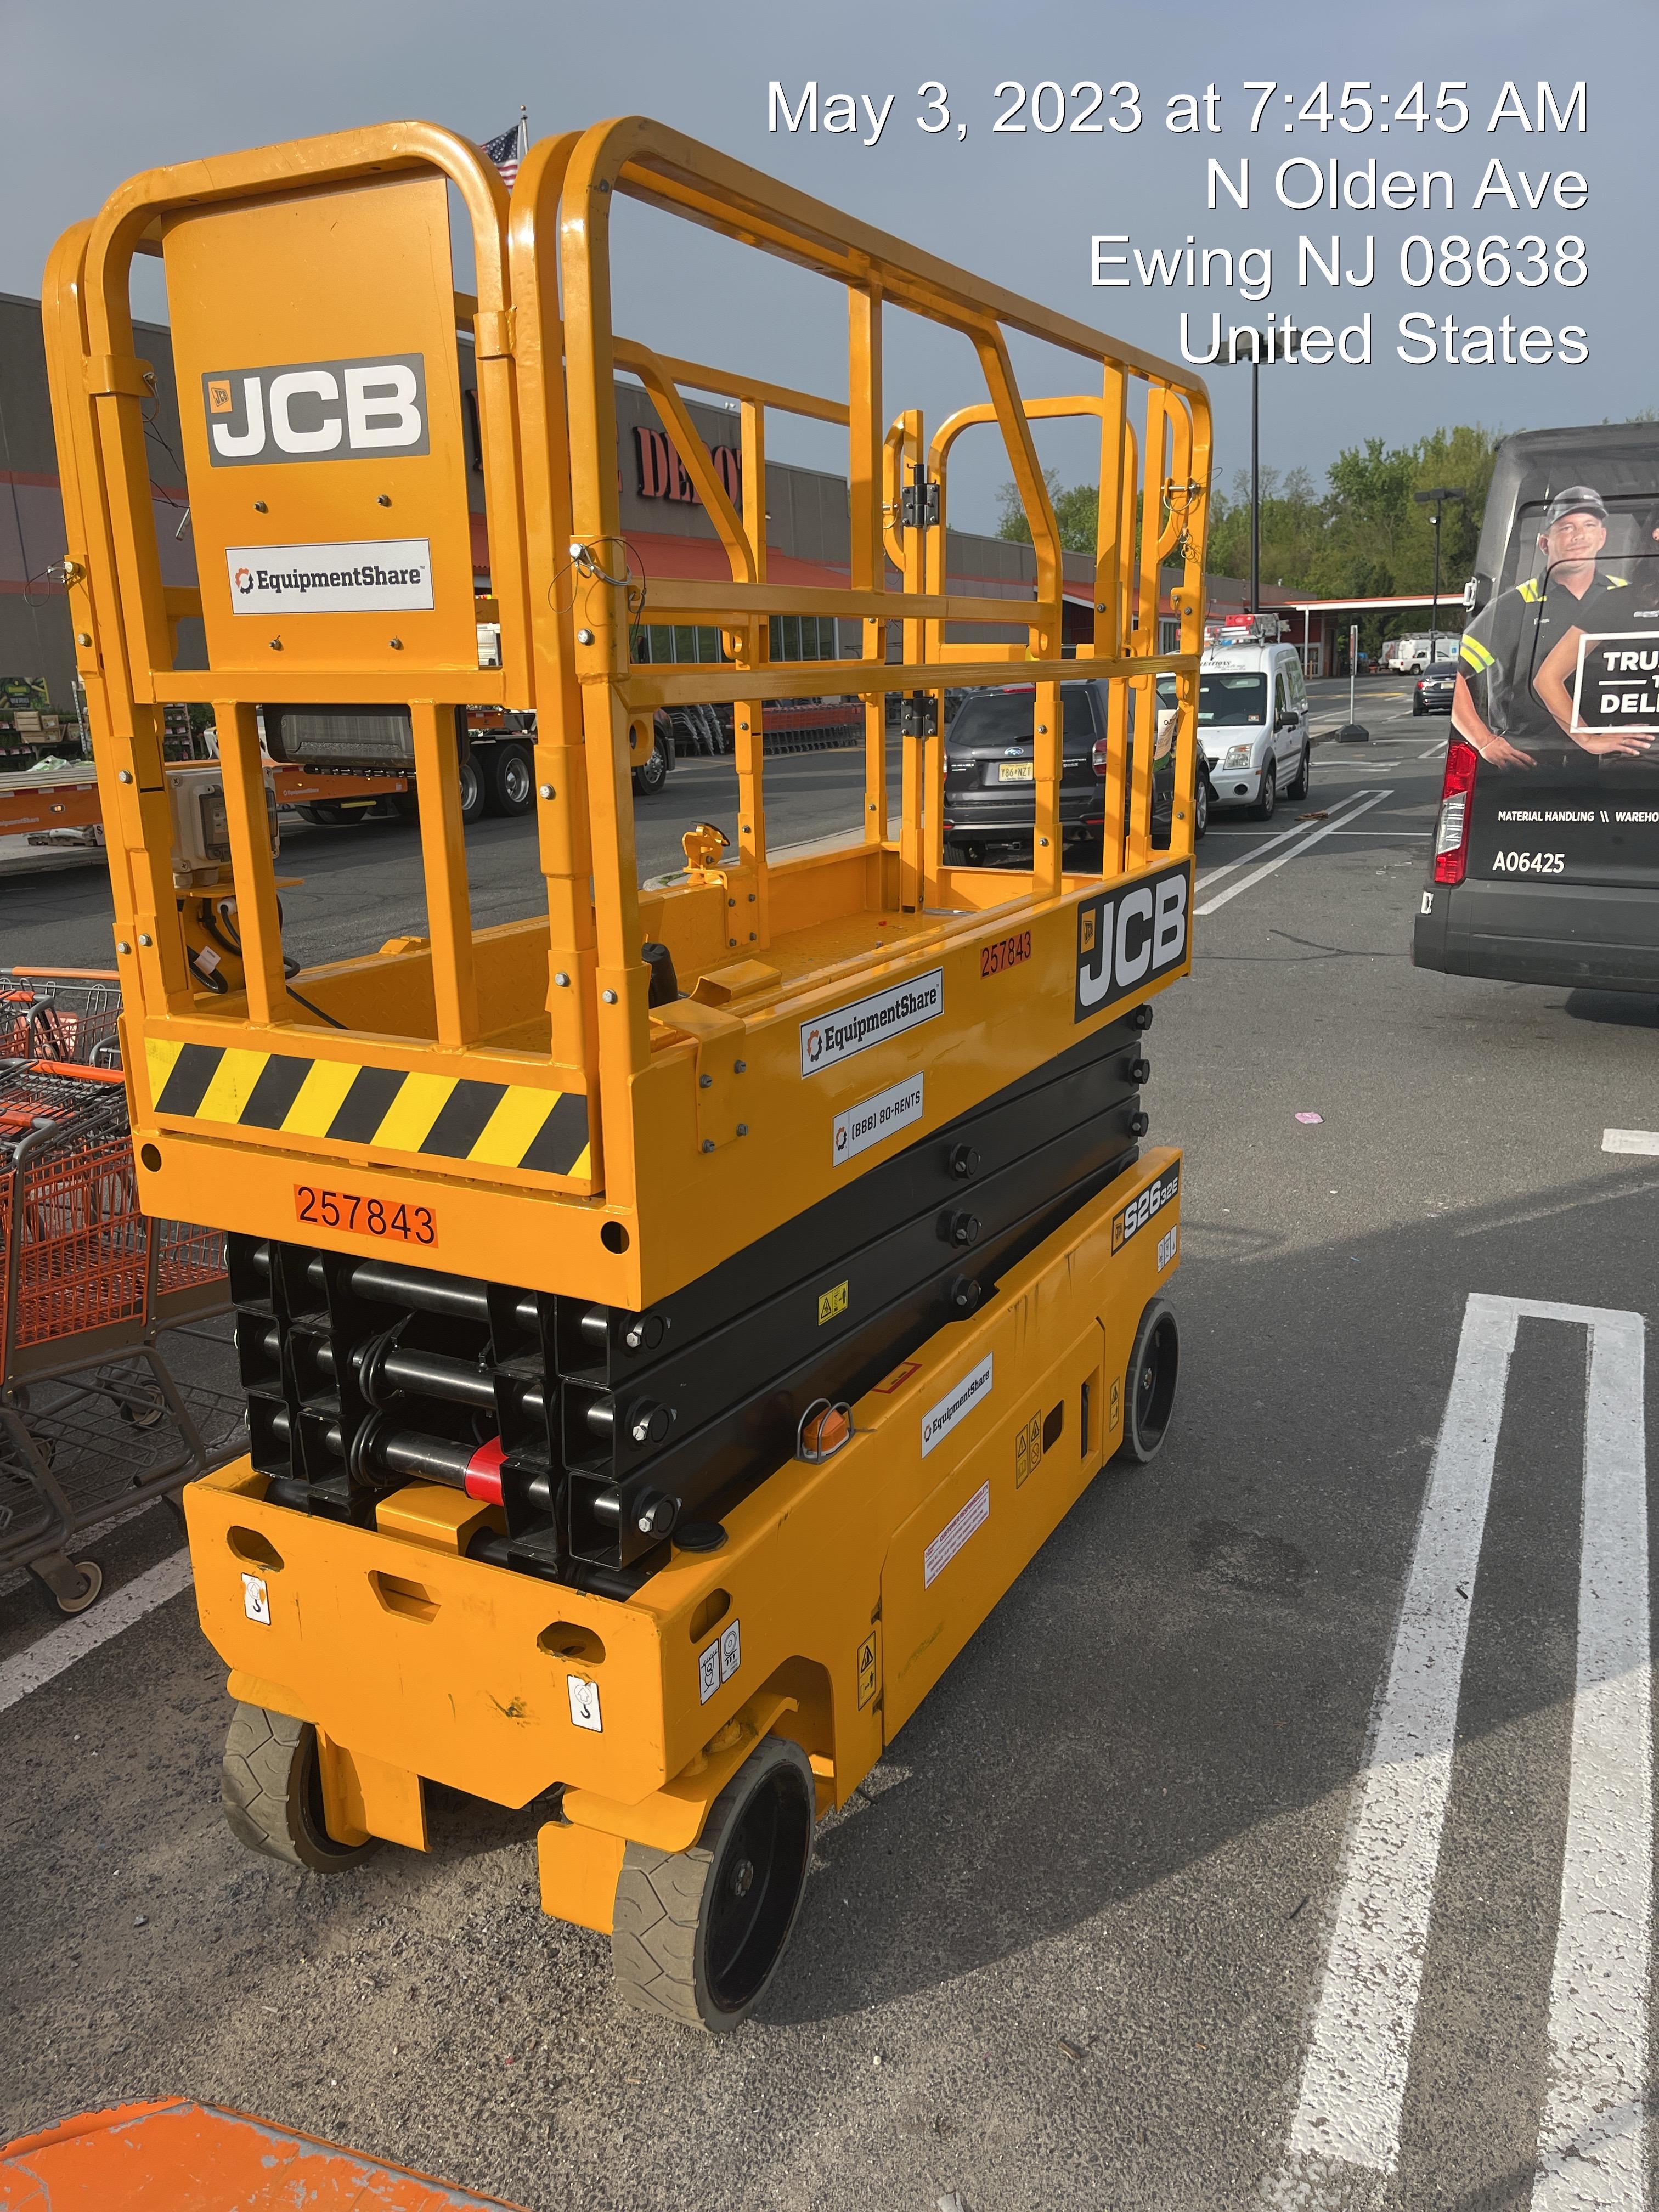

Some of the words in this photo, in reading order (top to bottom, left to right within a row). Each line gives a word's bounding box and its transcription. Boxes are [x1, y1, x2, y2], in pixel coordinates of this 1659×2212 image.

[212, 364, 421, 458] JCB
[1603, 651, 1659, 672] TRU
[1498, 811, 1543, 821] MATERIAL
[1545, 811, 1594, 822] HANDLING
[1615, 811, 1659, 822] WAREHO
[1492, 851, 1565, 873] A06425
[982, 931, 1031, 977] 257843
[1079, 874, 1186, 1006] JCB
[852, 1113, 877, 1141] (888)
[879, 1090, 921, 1124] 80-RENTS
[298, 1187, 435, 1244] 257843
[1124, 1180, 1161, 1239] S26
[1160, 1176, 1178, 1205] 32E
